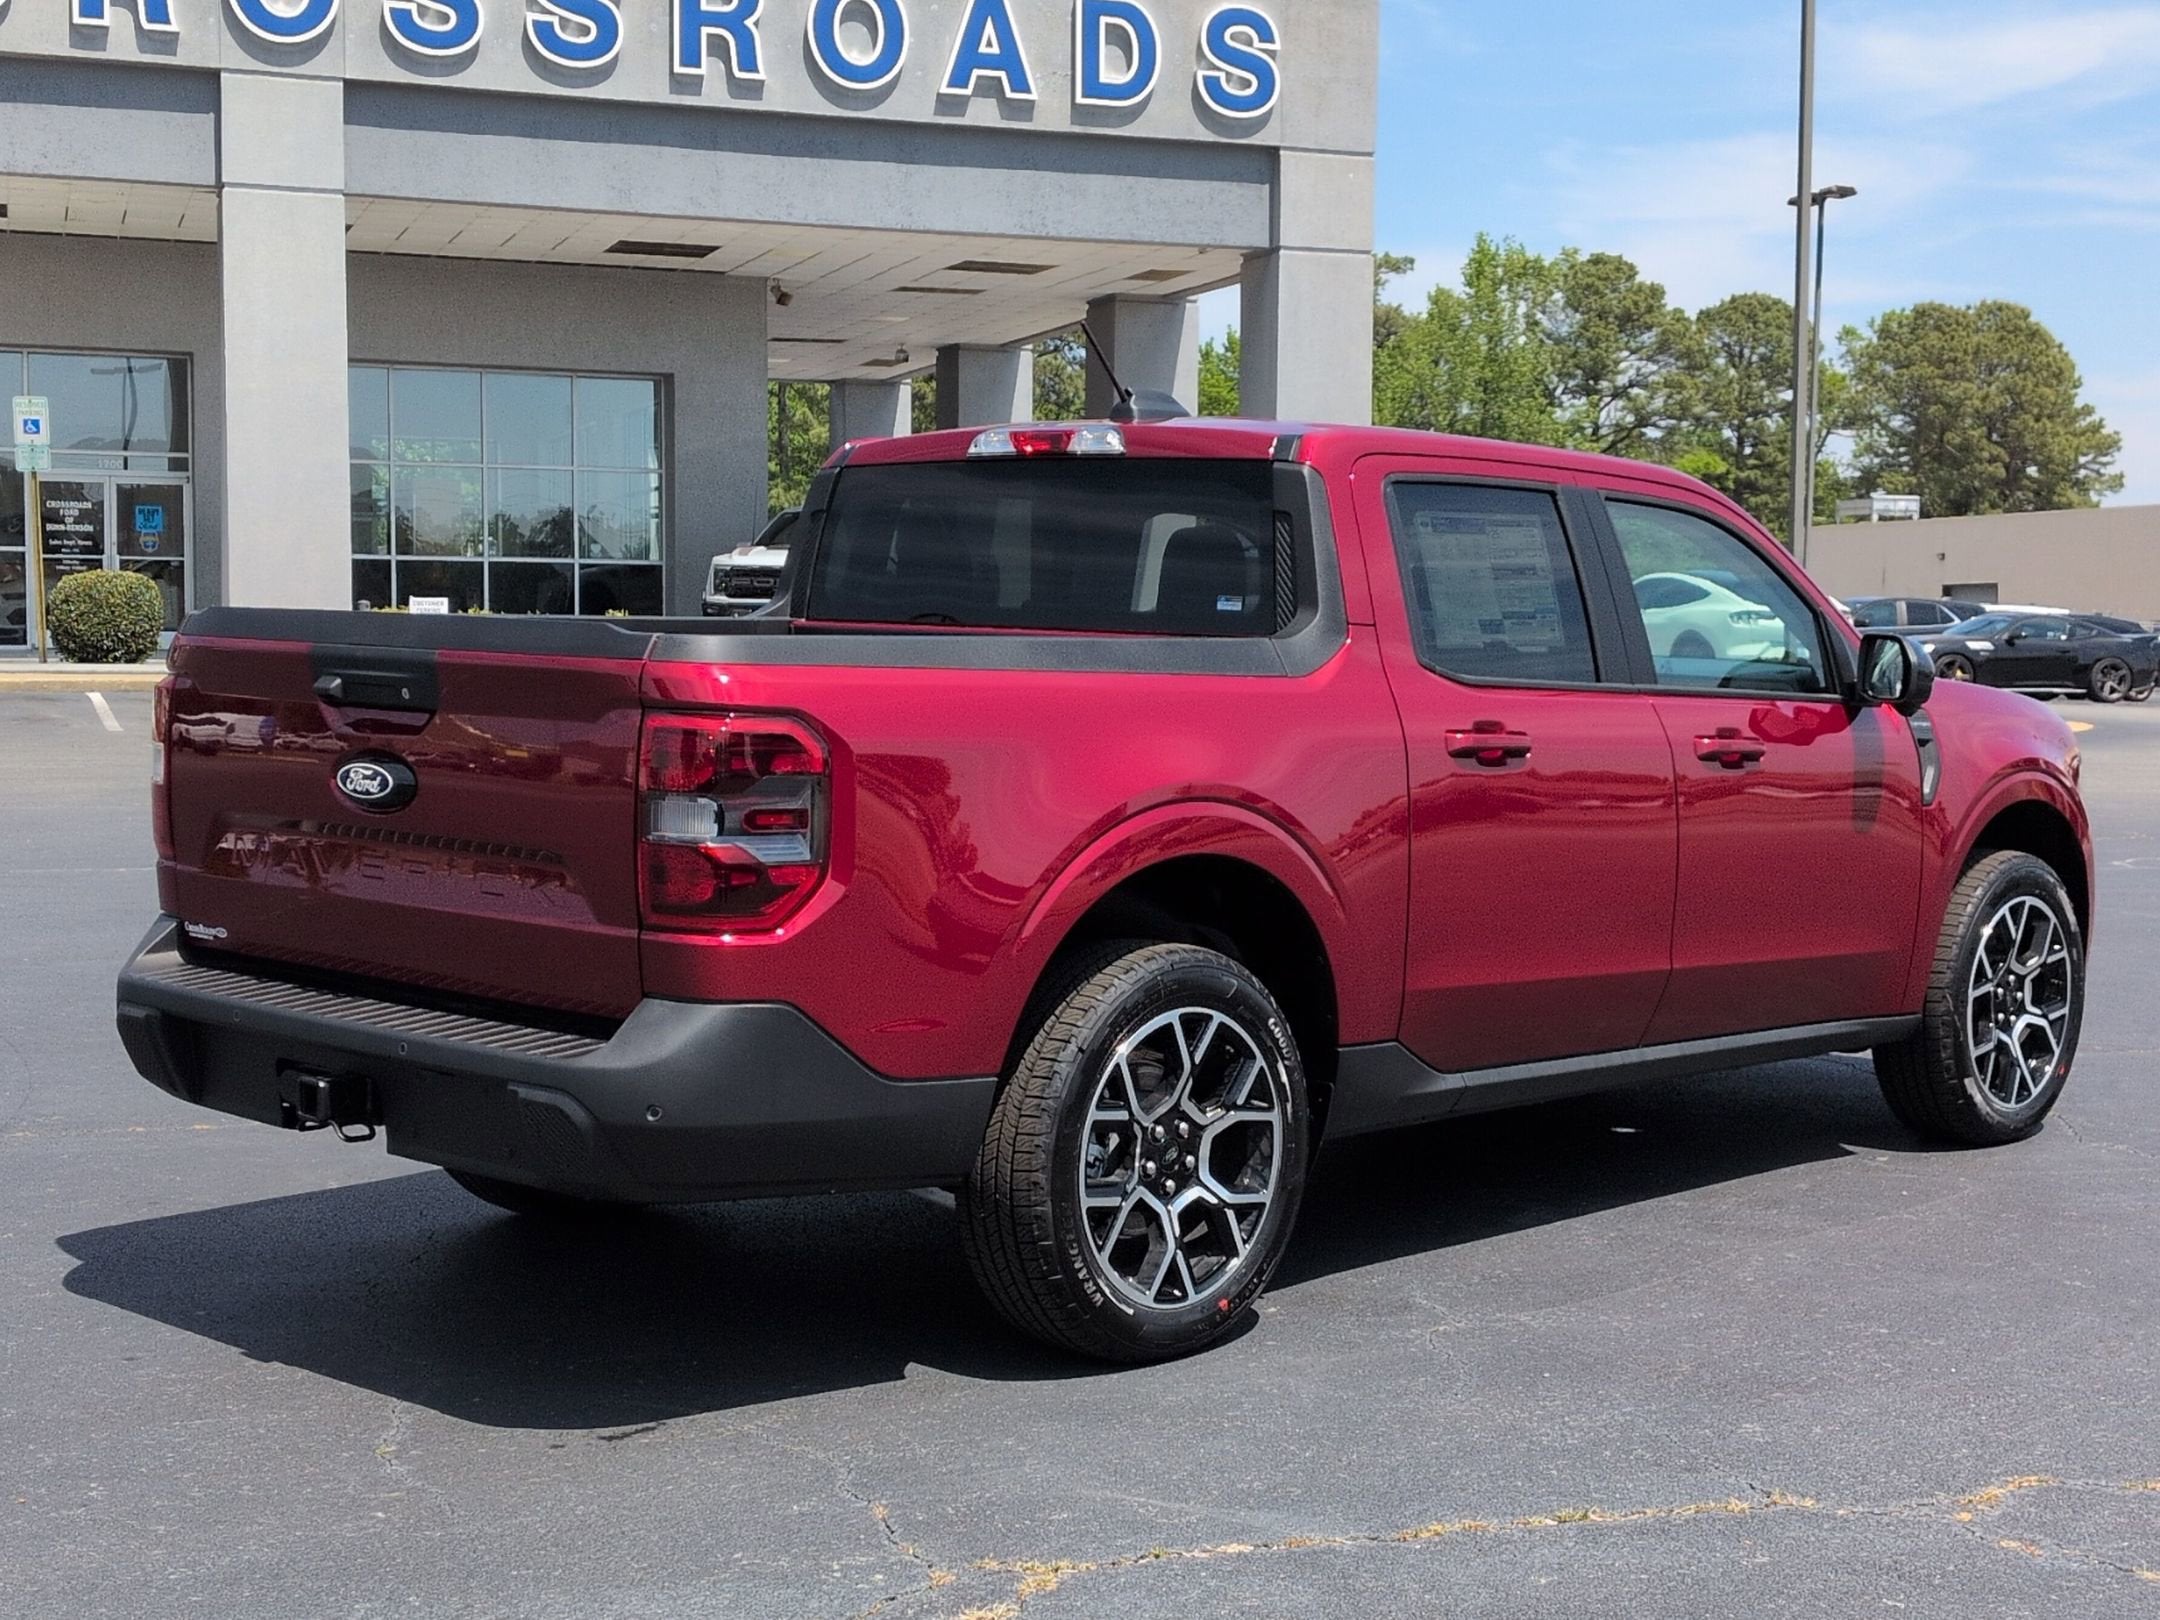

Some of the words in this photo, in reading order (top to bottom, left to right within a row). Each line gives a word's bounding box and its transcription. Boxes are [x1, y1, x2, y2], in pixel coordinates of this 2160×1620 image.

[0, 0, 1282, 118] SSROADS
[46, 500, 92, 509] CROSSROADS
[346, 767, 382, 793] Ford
